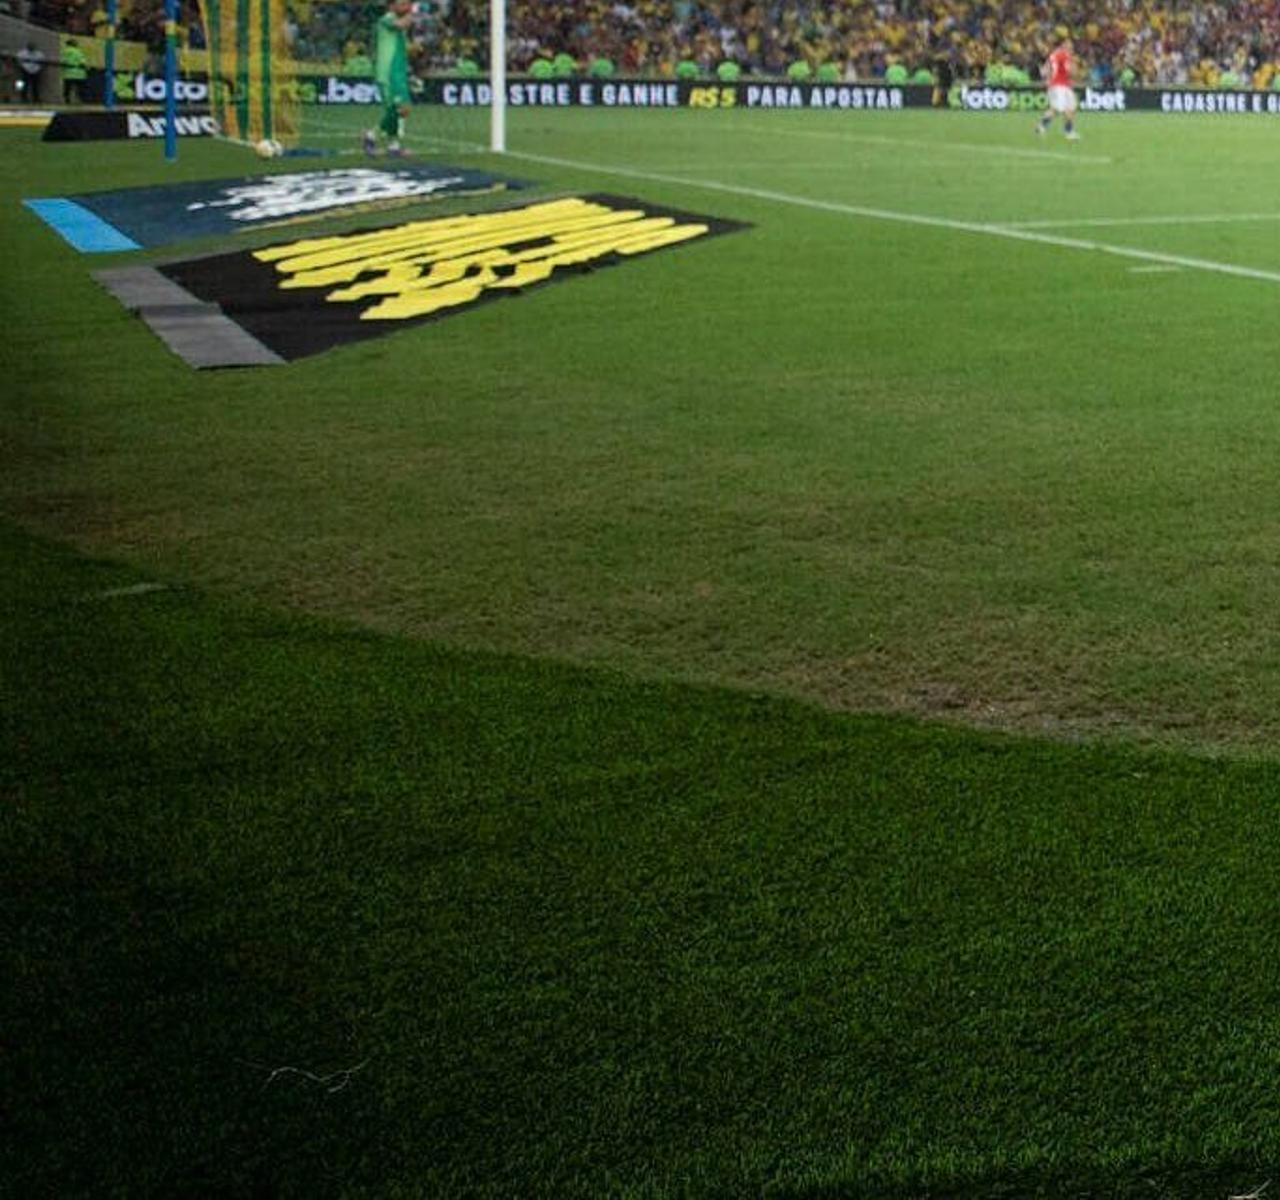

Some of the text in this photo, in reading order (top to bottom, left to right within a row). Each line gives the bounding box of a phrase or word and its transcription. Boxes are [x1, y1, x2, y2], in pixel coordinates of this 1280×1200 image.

[443, 83, 570, 105] CADSTRE
[579, 83, 593, 106] E
[602, 84, 679, 106] GANHE
[747, 85, 803, 106] PARA
[810, 87, 903, 108] APOSTAR
